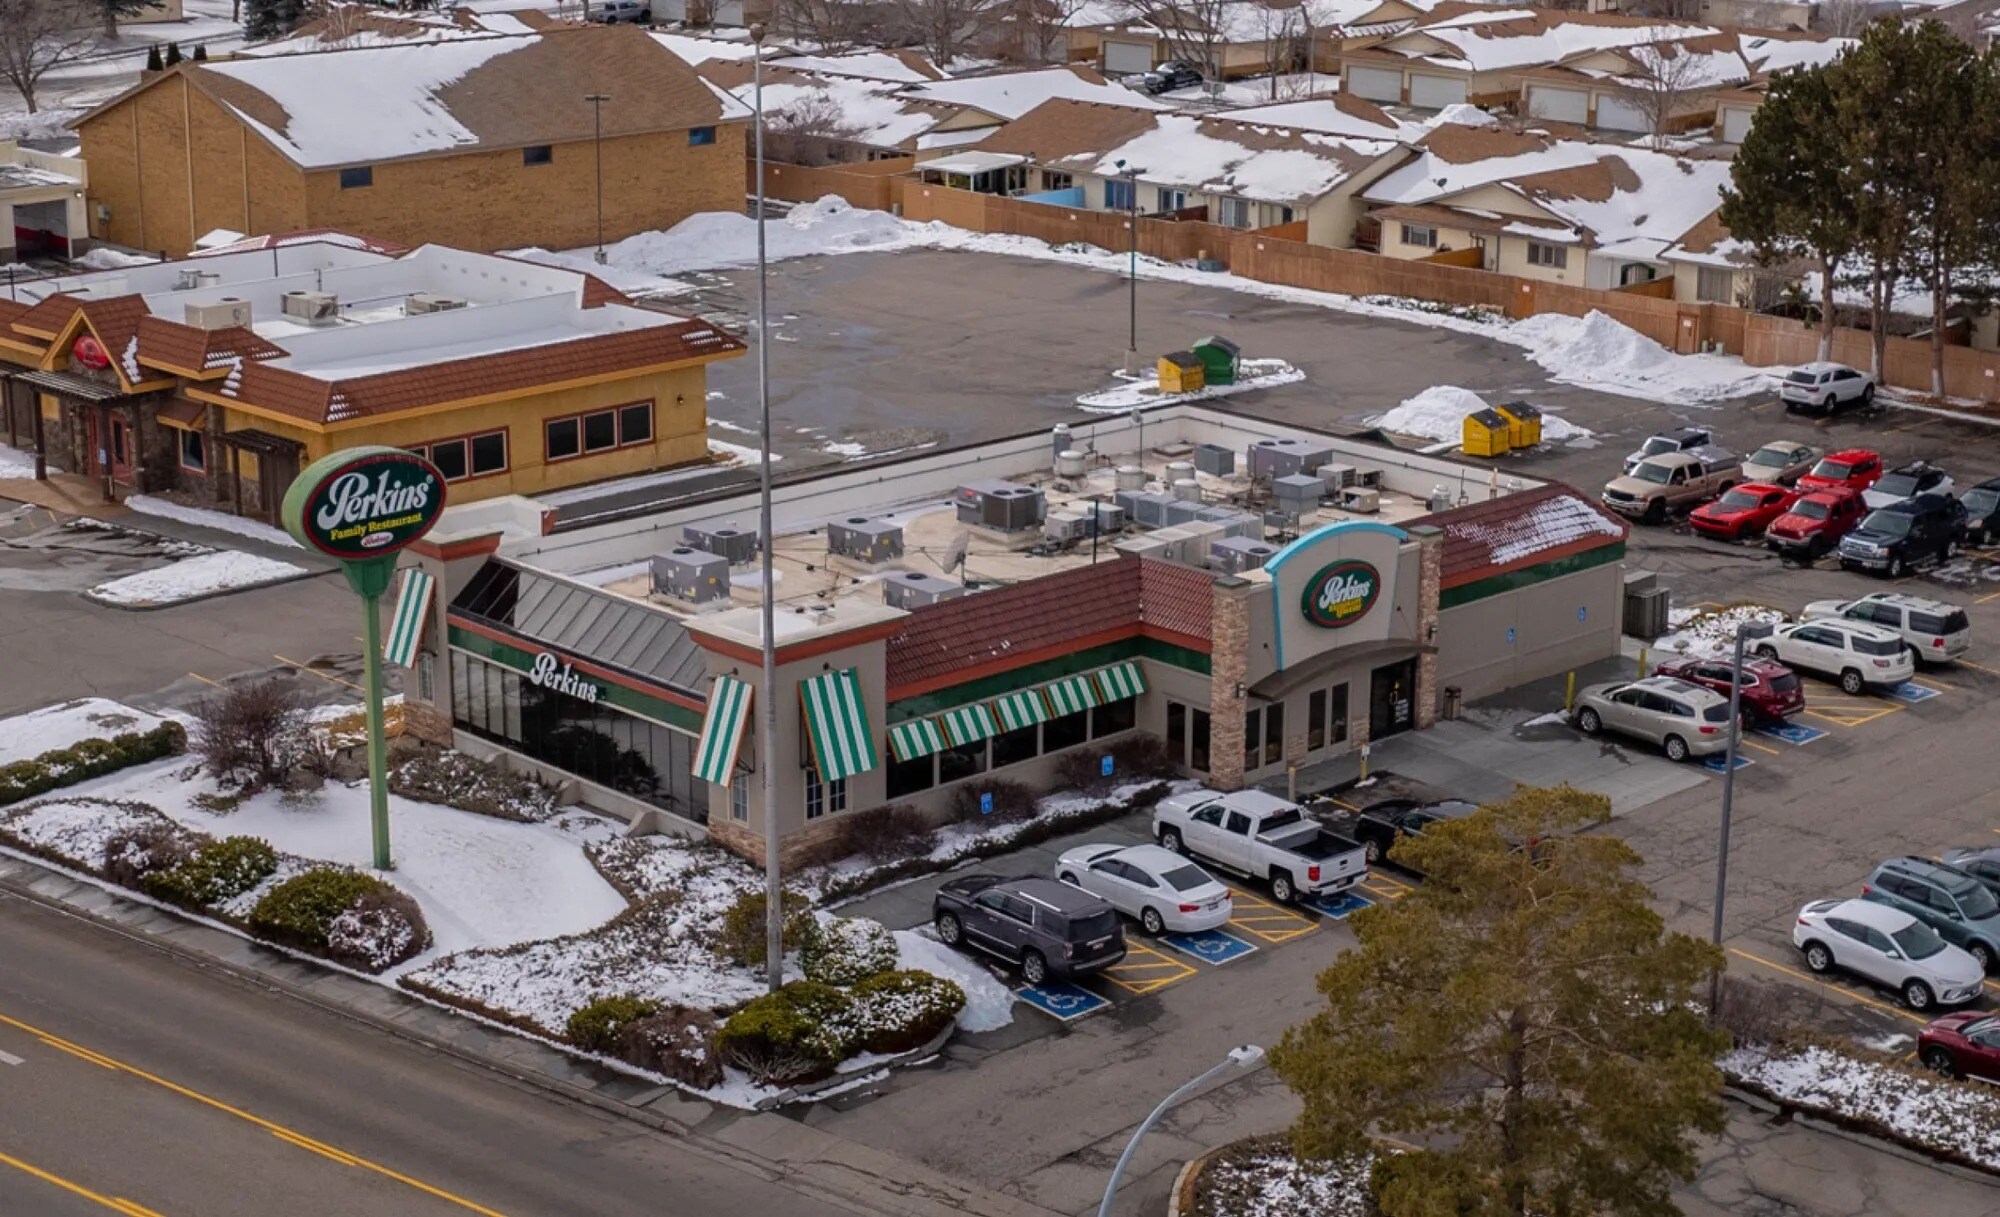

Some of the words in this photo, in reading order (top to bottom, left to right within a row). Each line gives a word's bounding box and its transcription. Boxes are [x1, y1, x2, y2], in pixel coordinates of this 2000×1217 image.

[317, 469, 429, 530] Perkins
[330, 524, 367, 541] Family
[368, 512, 423, 532] Restaurant
[1319, 573, 1371, 609] Perkins
[530, 652, 597, 703] Perkins
